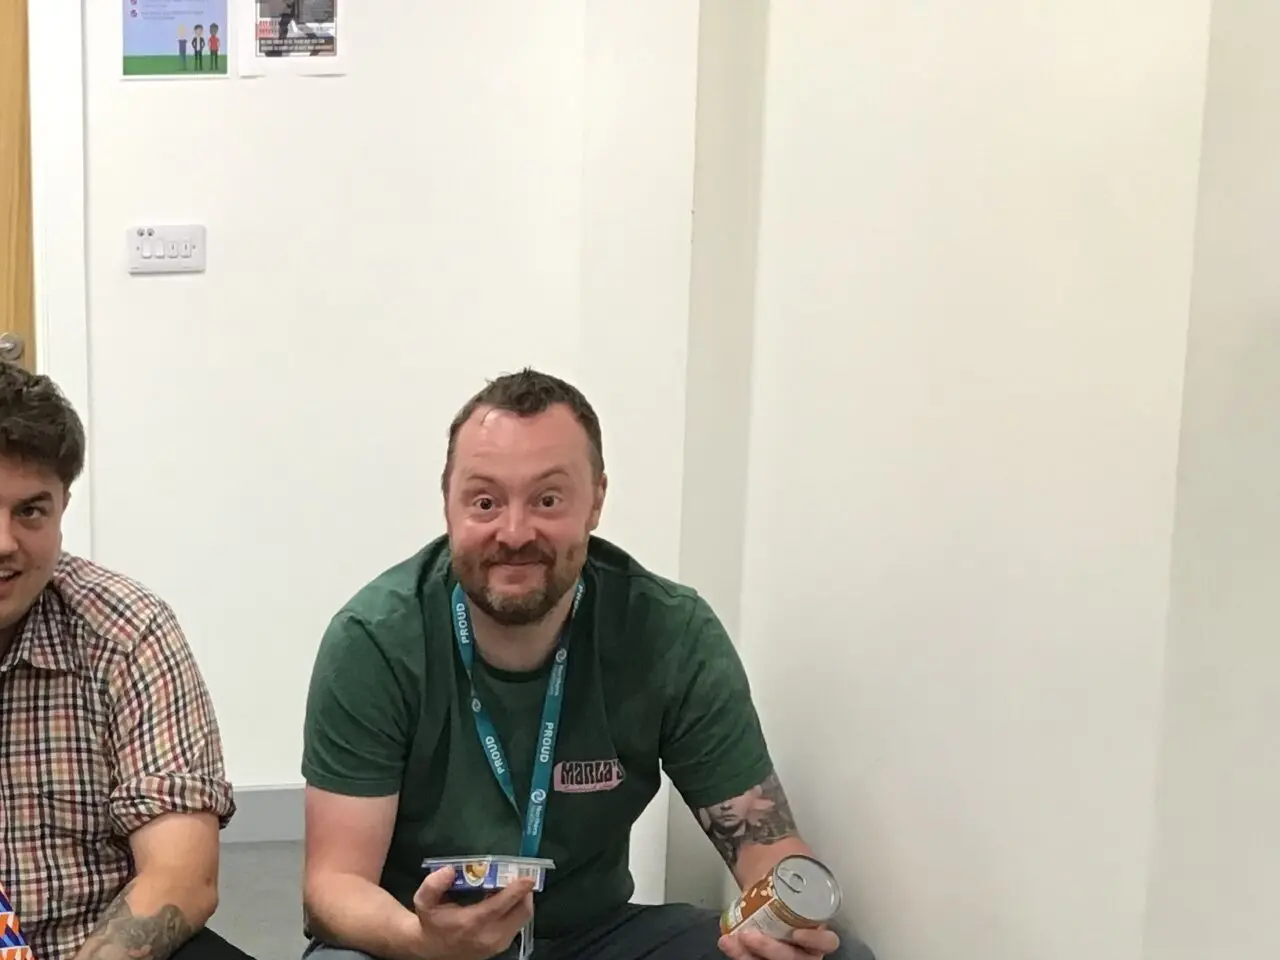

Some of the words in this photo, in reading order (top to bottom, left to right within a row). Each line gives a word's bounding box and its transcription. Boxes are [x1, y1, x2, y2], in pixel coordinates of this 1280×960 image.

[456, 603, 470, 644] PROUD
[485, 735, 505, 775] PROUD
[539, 721, 555, 763] PROUD
